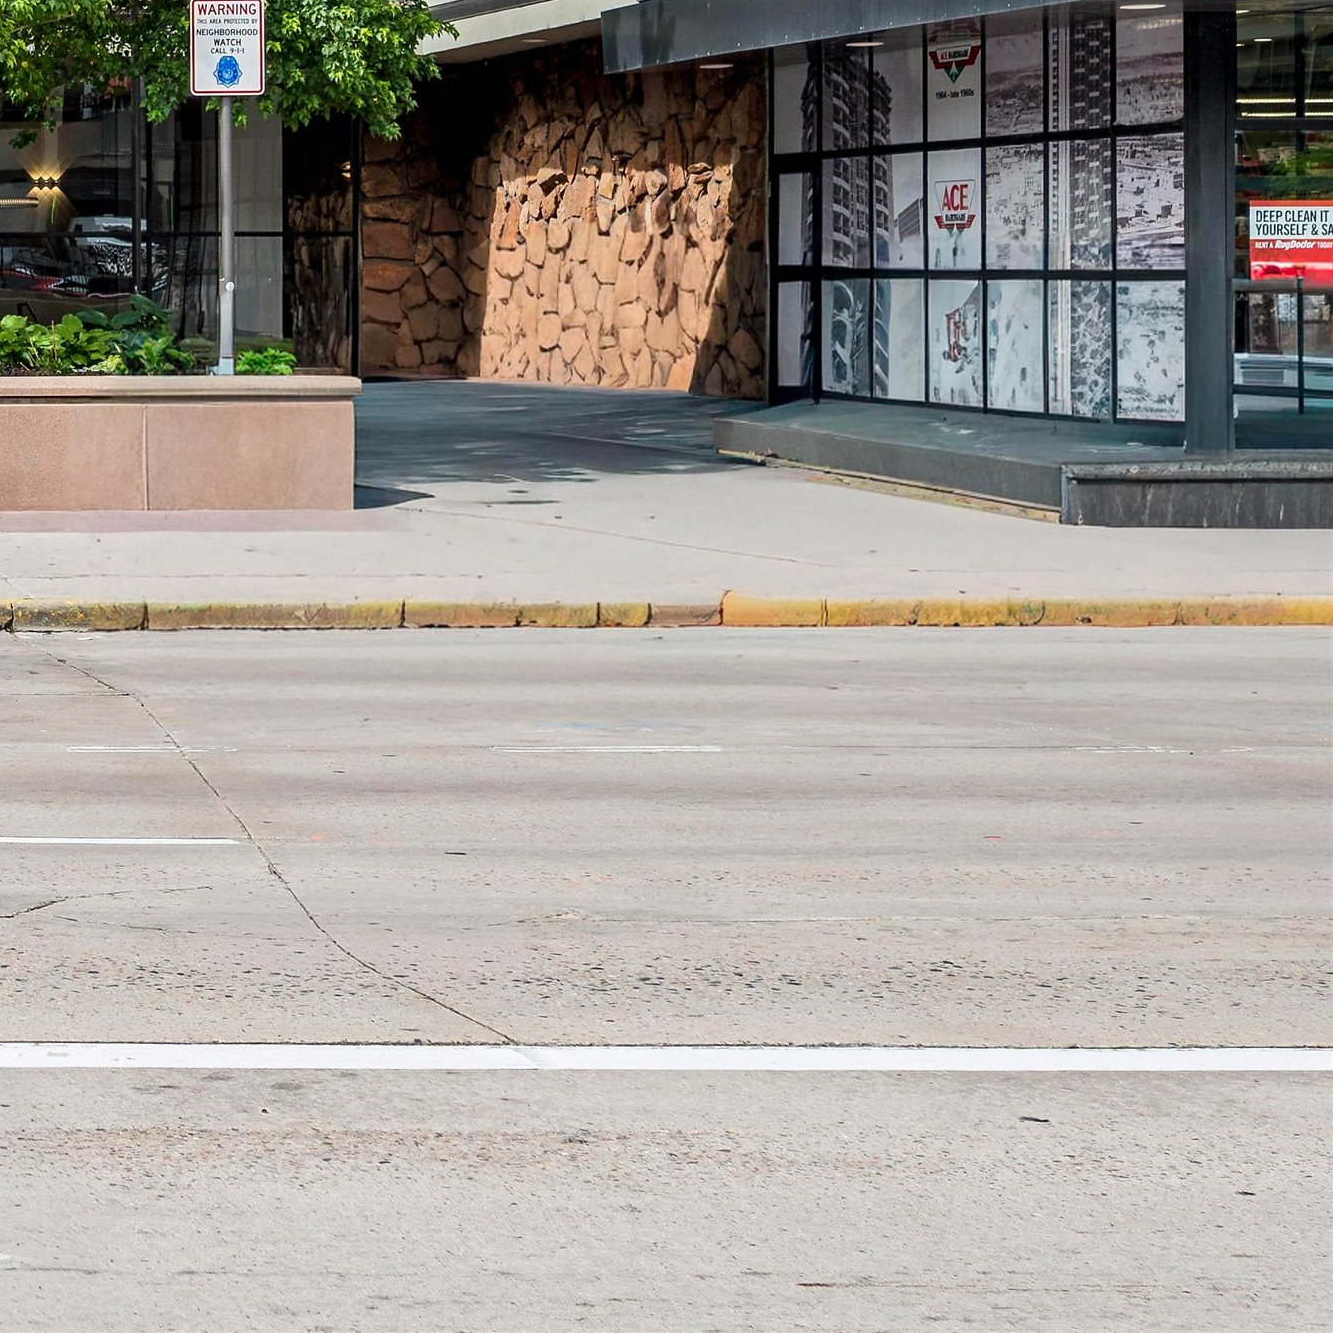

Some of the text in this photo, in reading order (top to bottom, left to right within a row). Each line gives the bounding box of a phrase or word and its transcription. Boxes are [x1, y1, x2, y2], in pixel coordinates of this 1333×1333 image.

[197, 3, 257, 15] WARNING
[196, 28, 258, 36] NEIGHBORHOOD
[213, 38, 242, 46] WATCH
[941, 184, 969, 211] ACE
[1255, 210, 1329, 222] DEEP CLEAN IT
[1255, 223, 1308, 236] YOURSELF
[1310, 223, 1319, 236] &
